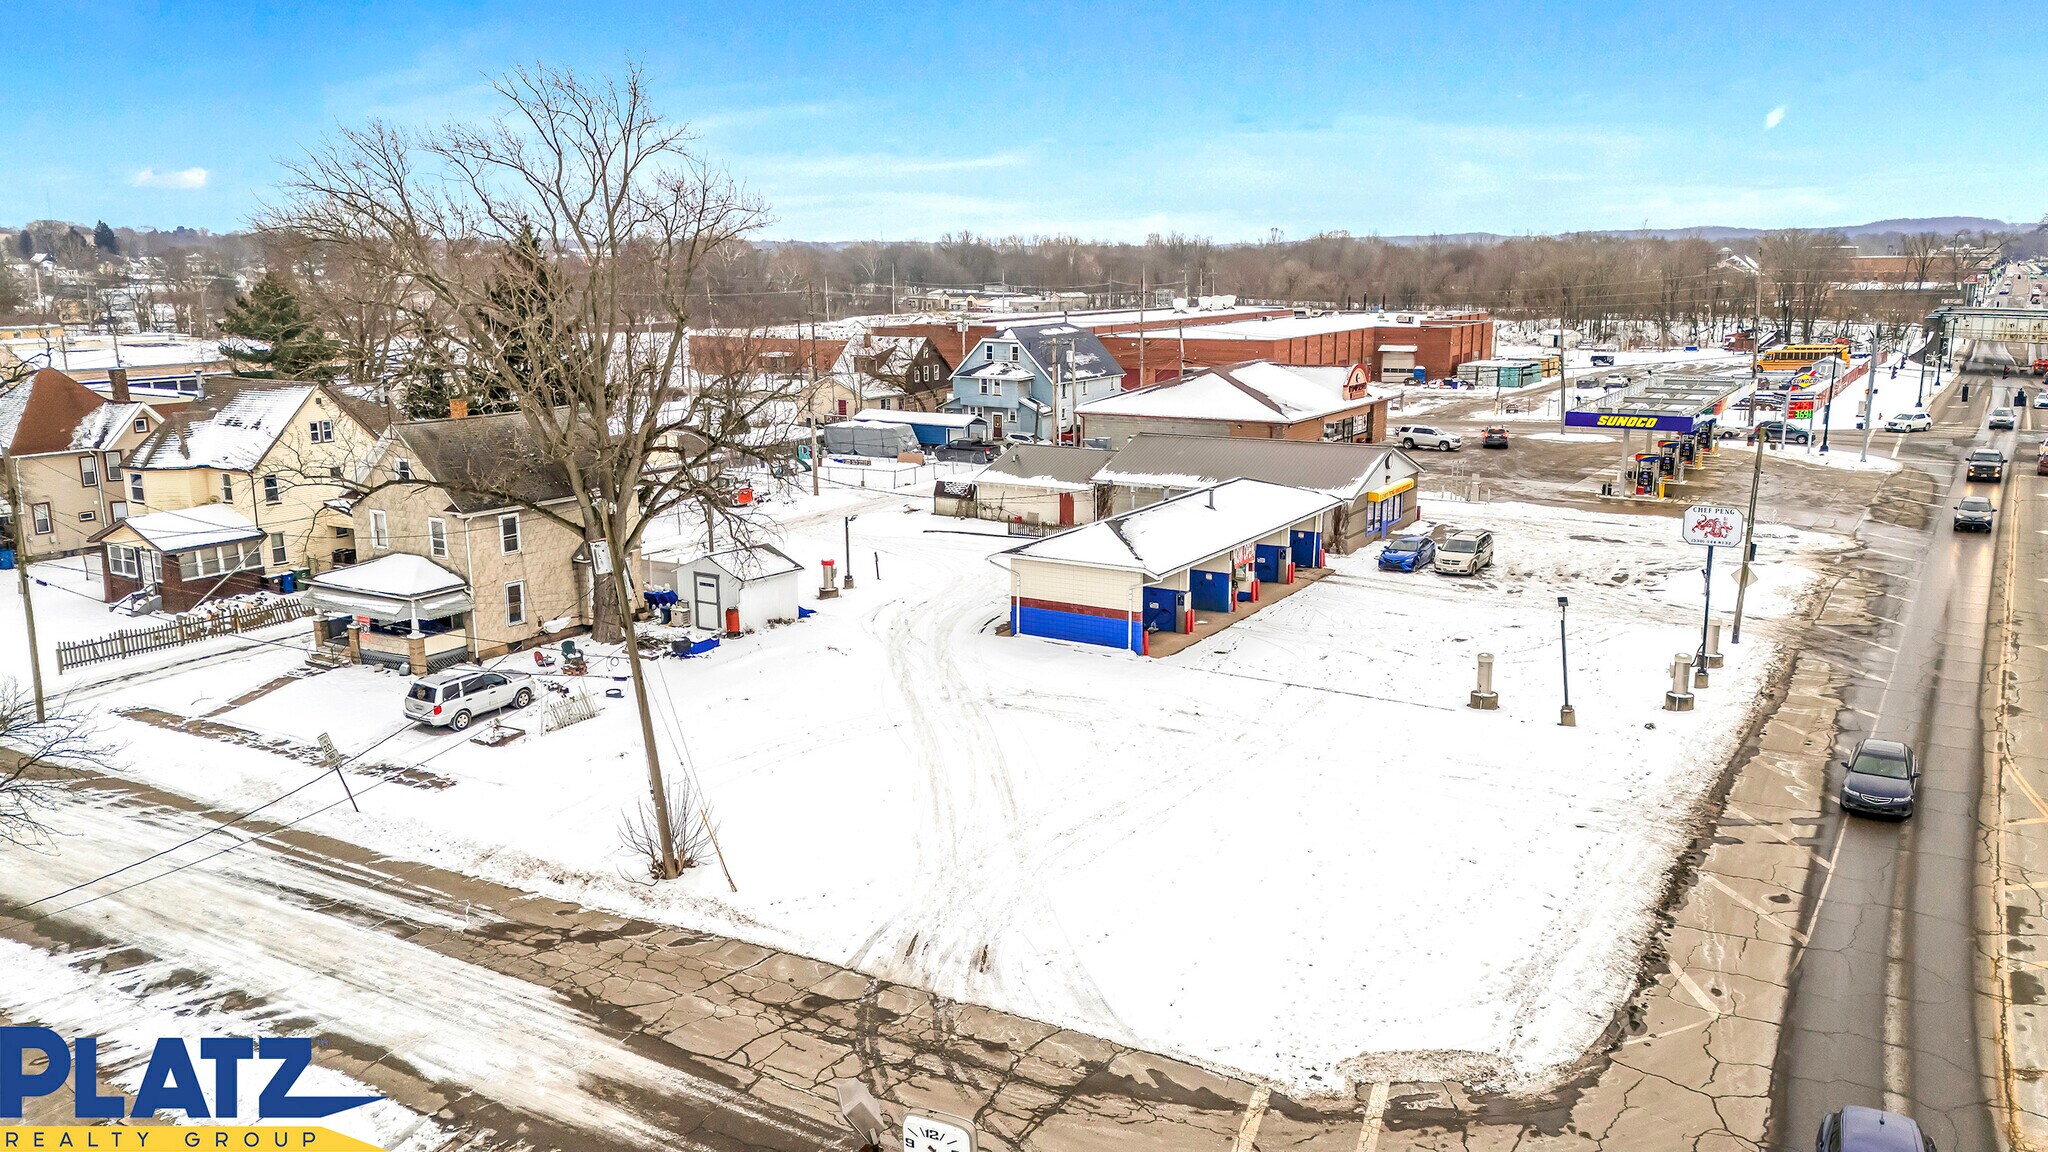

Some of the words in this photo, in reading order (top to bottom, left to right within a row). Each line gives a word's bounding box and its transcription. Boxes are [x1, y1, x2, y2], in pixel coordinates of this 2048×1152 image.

[1597, 415, 1658, 428] SUNOCO
[323, 743, 332, 753] 20
[925, 1129, 939, 1141] 12
